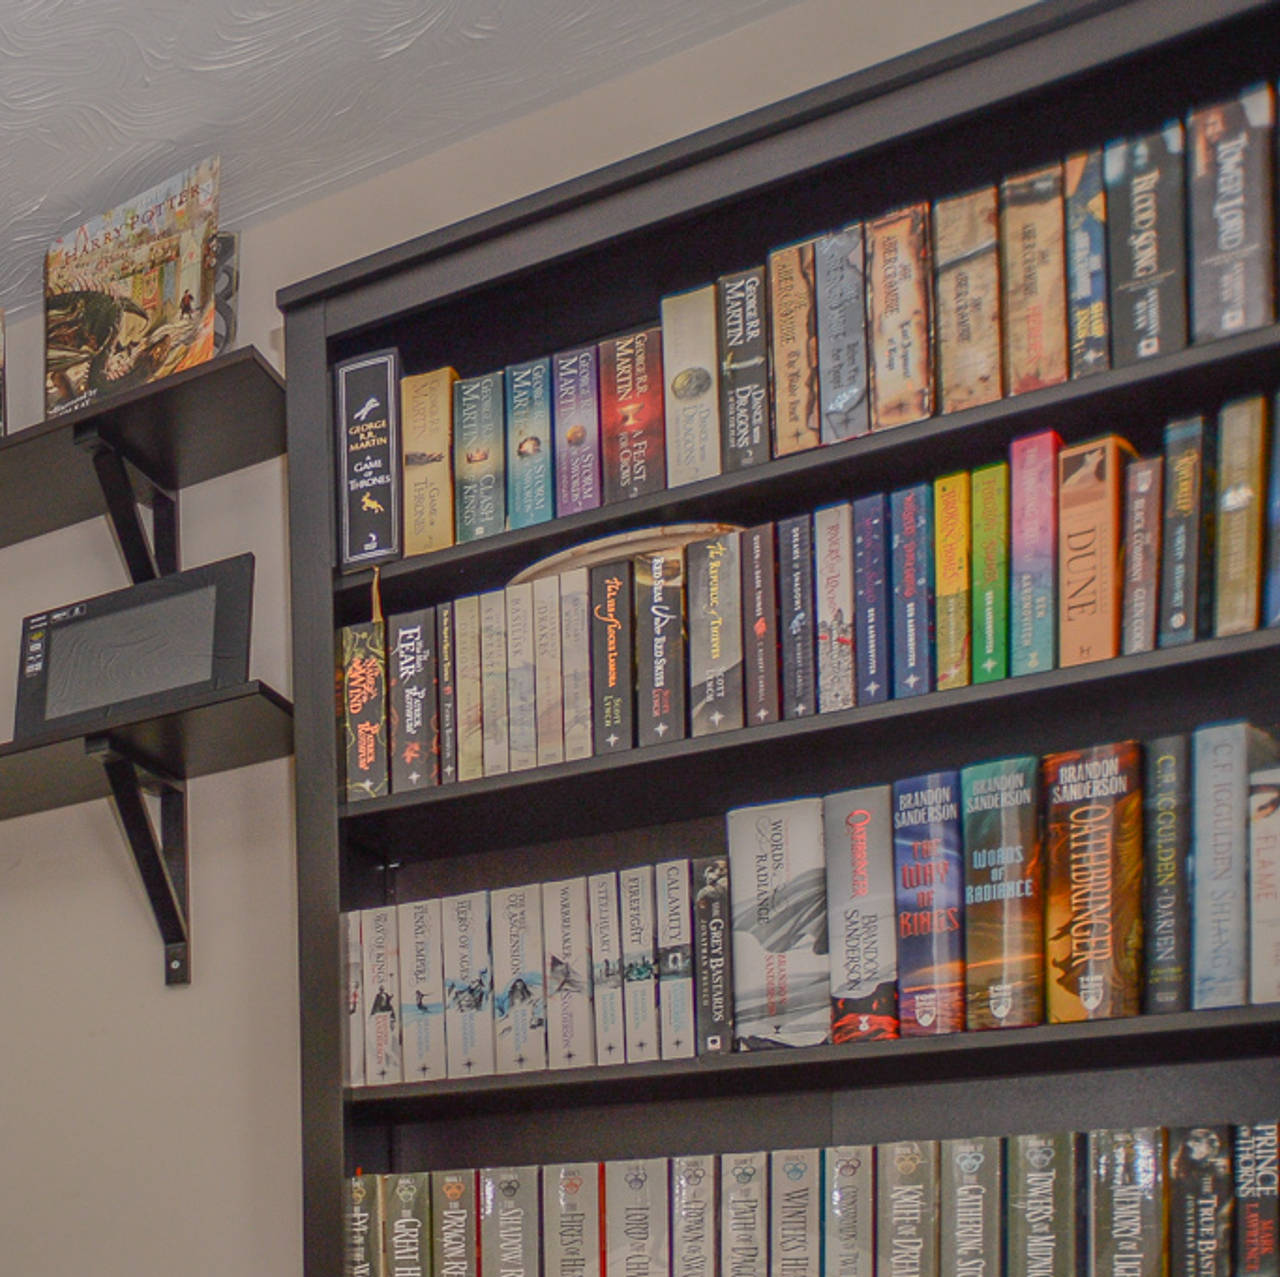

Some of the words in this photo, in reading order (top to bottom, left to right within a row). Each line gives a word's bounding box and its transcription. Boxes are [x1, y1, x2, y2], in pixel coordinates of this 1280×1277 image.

[64, 228, 123, 265] HARRY
[130, 184, 200, 230] POTTER
[1128, 231, 1157, 277] SONG
[725, 280, 744, 347] MARTIN
[616, 338, 635, 402] MARTIN
[348, 419, 388, 435] GEORGE
[736, 386, 750, 449] DRAGONS
[751, 389, 765, 424] DANCE
[348, 437, 388, 451] MARTIN
[354, 460, 383, 472] GAME
[633, 440, 647, 482] FEAST
[348, 474, 391, 491] THRONES
[620, 449, 632, 488] CROWS
[464, 485, 477, 526] KINGS
[479, 474, 495, 523] CLASH
[709, 561, 721, 607] REPUBLIC
[1067, 526, 1097, 622] DUNE
[396, 626, 421, 685] FEAR
[348, 676, 366, 714] WIND
[604, 696, 614, 727] LYNCH
[613, 697, 621, 724] SCOTT
[972, 772, 1024, 796] BRANDON
[1051, 775, 1128, 804] SANDERSON
[1059, 758, 1120, 785] BRANDON
[894, 804, 957, 829] SANDERSON
[899, 787, 951, 811] BRANDON
[966, 787, 1032, 813] SANDERSON
[770, 818, 785, 872] WORDS
[845, 809, 871, 899] OATHBRINGER
[1155, 791, 1177, 887] IGGULDEN
[1210, 781, 1234, 882] IGGULDEN
[901, 860, 950, 889] WAY
[972, 845, 1024, 870] WORDS
[1255, 833, 1278, 904] FLAME
[666, 865, 681, 941] CALAMITY
[755, 854, 770, 925] RADIANCE
[965, 879, 1034, 905] RADIANCE
[1069, 804, 1113, 968] OATHBRINGER
[457, 901, 471, 931] HERO
[559, 886, 572, 960] WARBREAKER
[629, 876, 644, 945] FIREFIGHT
[899, 907, 960, 938] KINGS
[1154, 896, 1176, 961] DARIEN
[1208, 889, 1232, 969] SHIANG
[509, 911, 520, 977] ASCENSION
[709, 918, 725, 955] GREY
[844, 909, 863, 991] SANDERSON
[860, 914, 879, 983] BRANDON
[413, 940, 428, 984] EMPIRE
[778, 955, 788, 1004] BRANDON
[711, 957, 725, 1022] BASTARDS
[560, 991, 573, 1049] SANDERSON
[1235, 1138, 1257, 1198] THORNS
[1251, 1123, 1279, 1198] PRINCE
[730, 1199, 759, 1232] PATH
[889, 1184, 925, 1224] KNIFE
[1024, 1167, 1057, 1223] TOWERS
[1196, 1194, 1219, 1237] TRUE
[392, 1217, 423, 1262] GREAT
[441, 1208, 468, 1258] DRAGON
[498, 1206, 525, 1265] SHADOW
[559, 1212, 587, 1247] FIRES
[623, 1206, 650, 1241] LORD
[955, 1184, 987, 1256] GATHERING
[1185, 1195, 1195, 1249] JONATHAN
[1244, 1203, 1261, 1272] LAWRENCE
[1260, 1219, 1275, 1255] MARK
